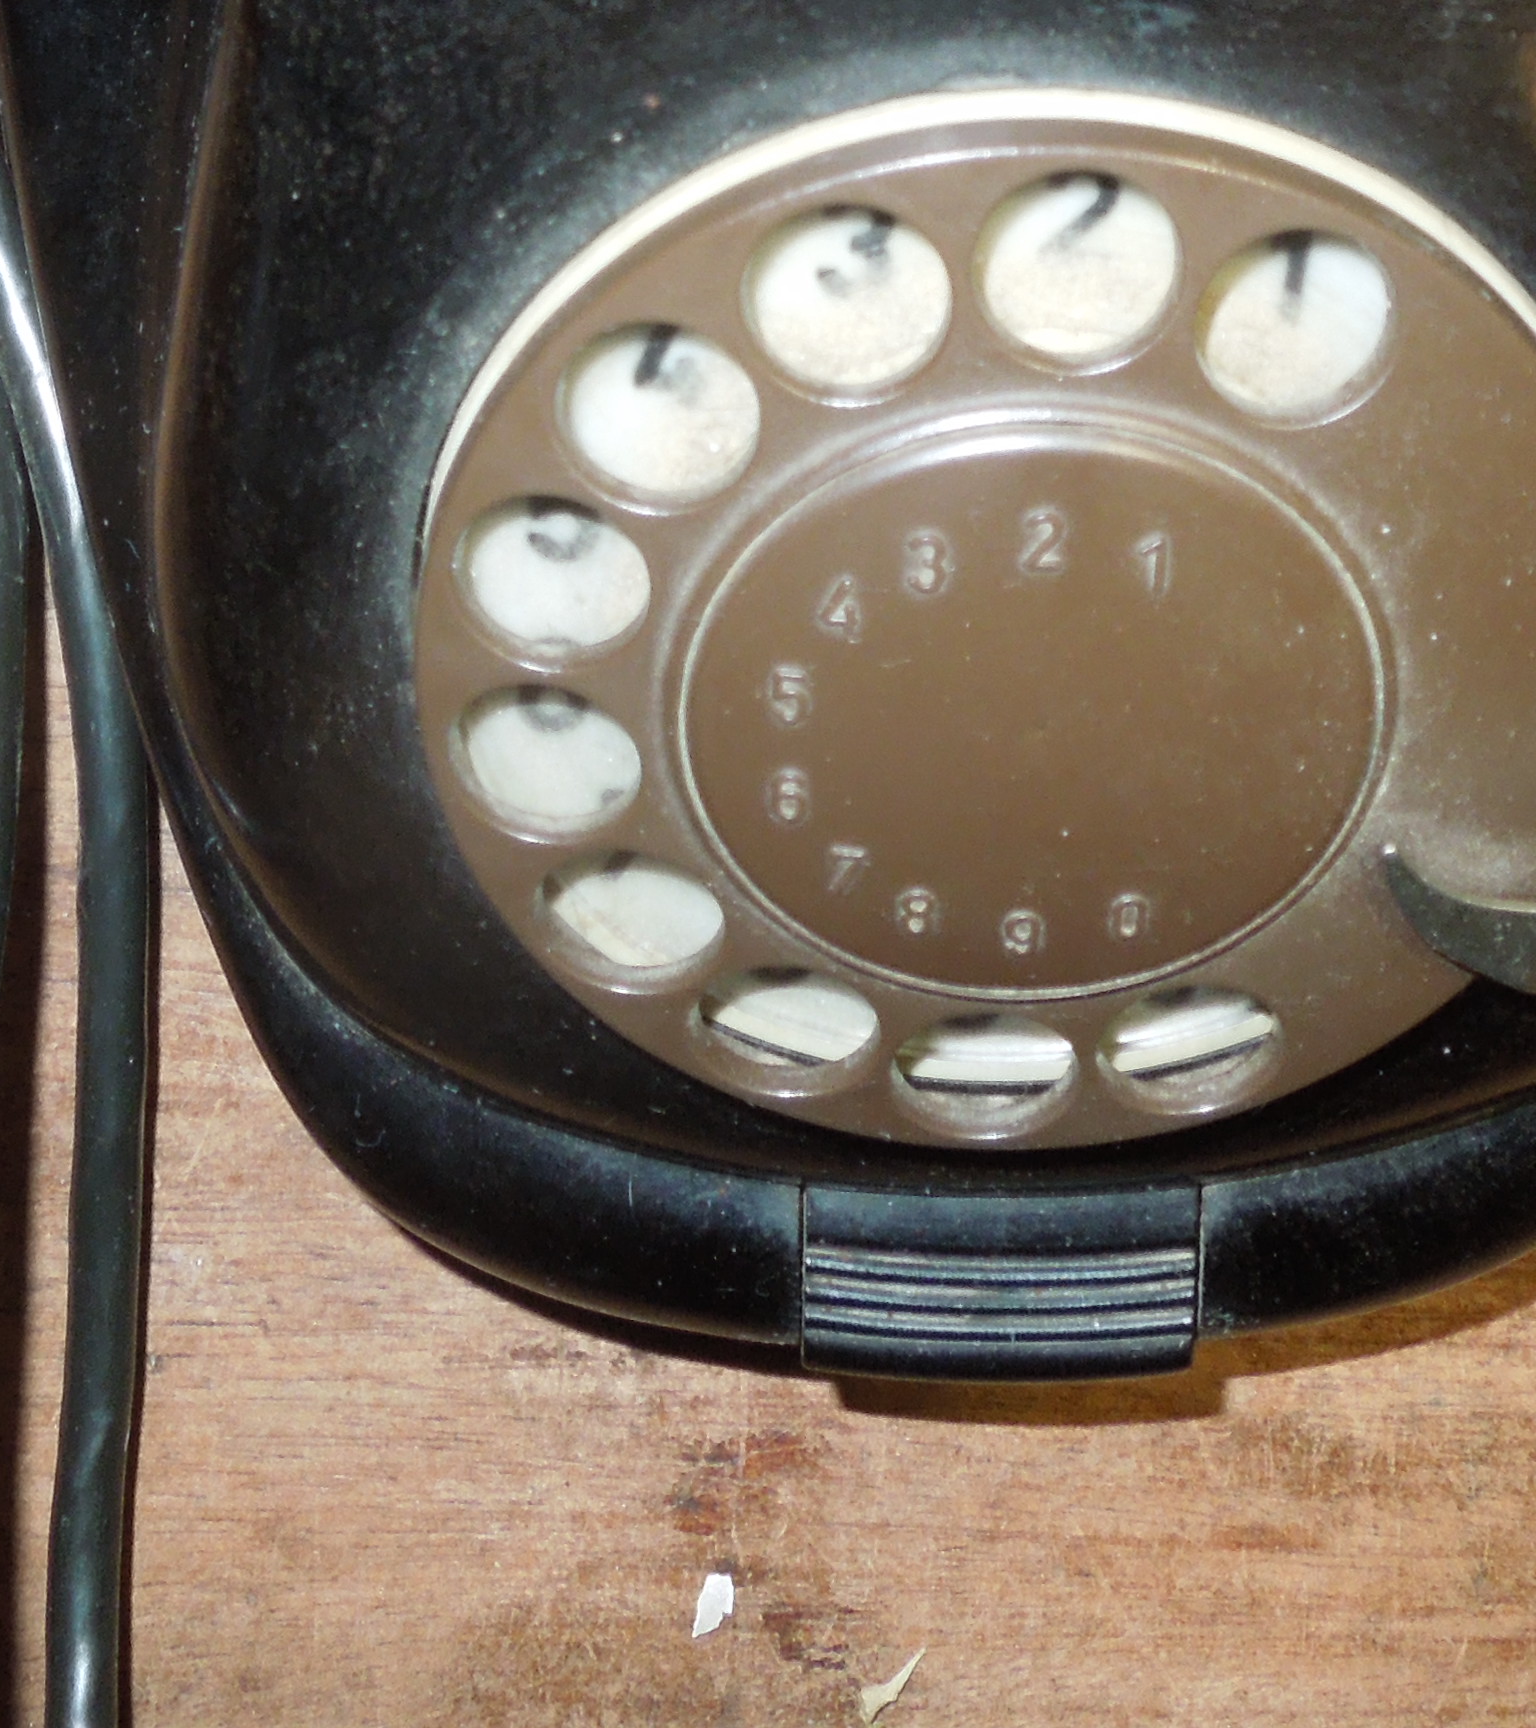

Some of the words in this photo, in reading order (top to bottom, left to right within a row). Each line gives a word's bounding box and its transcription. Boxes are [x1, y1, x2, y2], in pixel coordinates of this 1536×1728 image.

[904, 528, 951, 597] 3
[1020, 506, 1066, 575] 2
[1132, 531, 1172, 600] 1
[817, 575, 862, 643] 4
[767, 663, 812, 727] 5
[767, 764, 811, 827] 6
[825, 841, 869, 893] 7
[895, 885, 939, 936] 8
[999, 908, 1046, 957] 9
